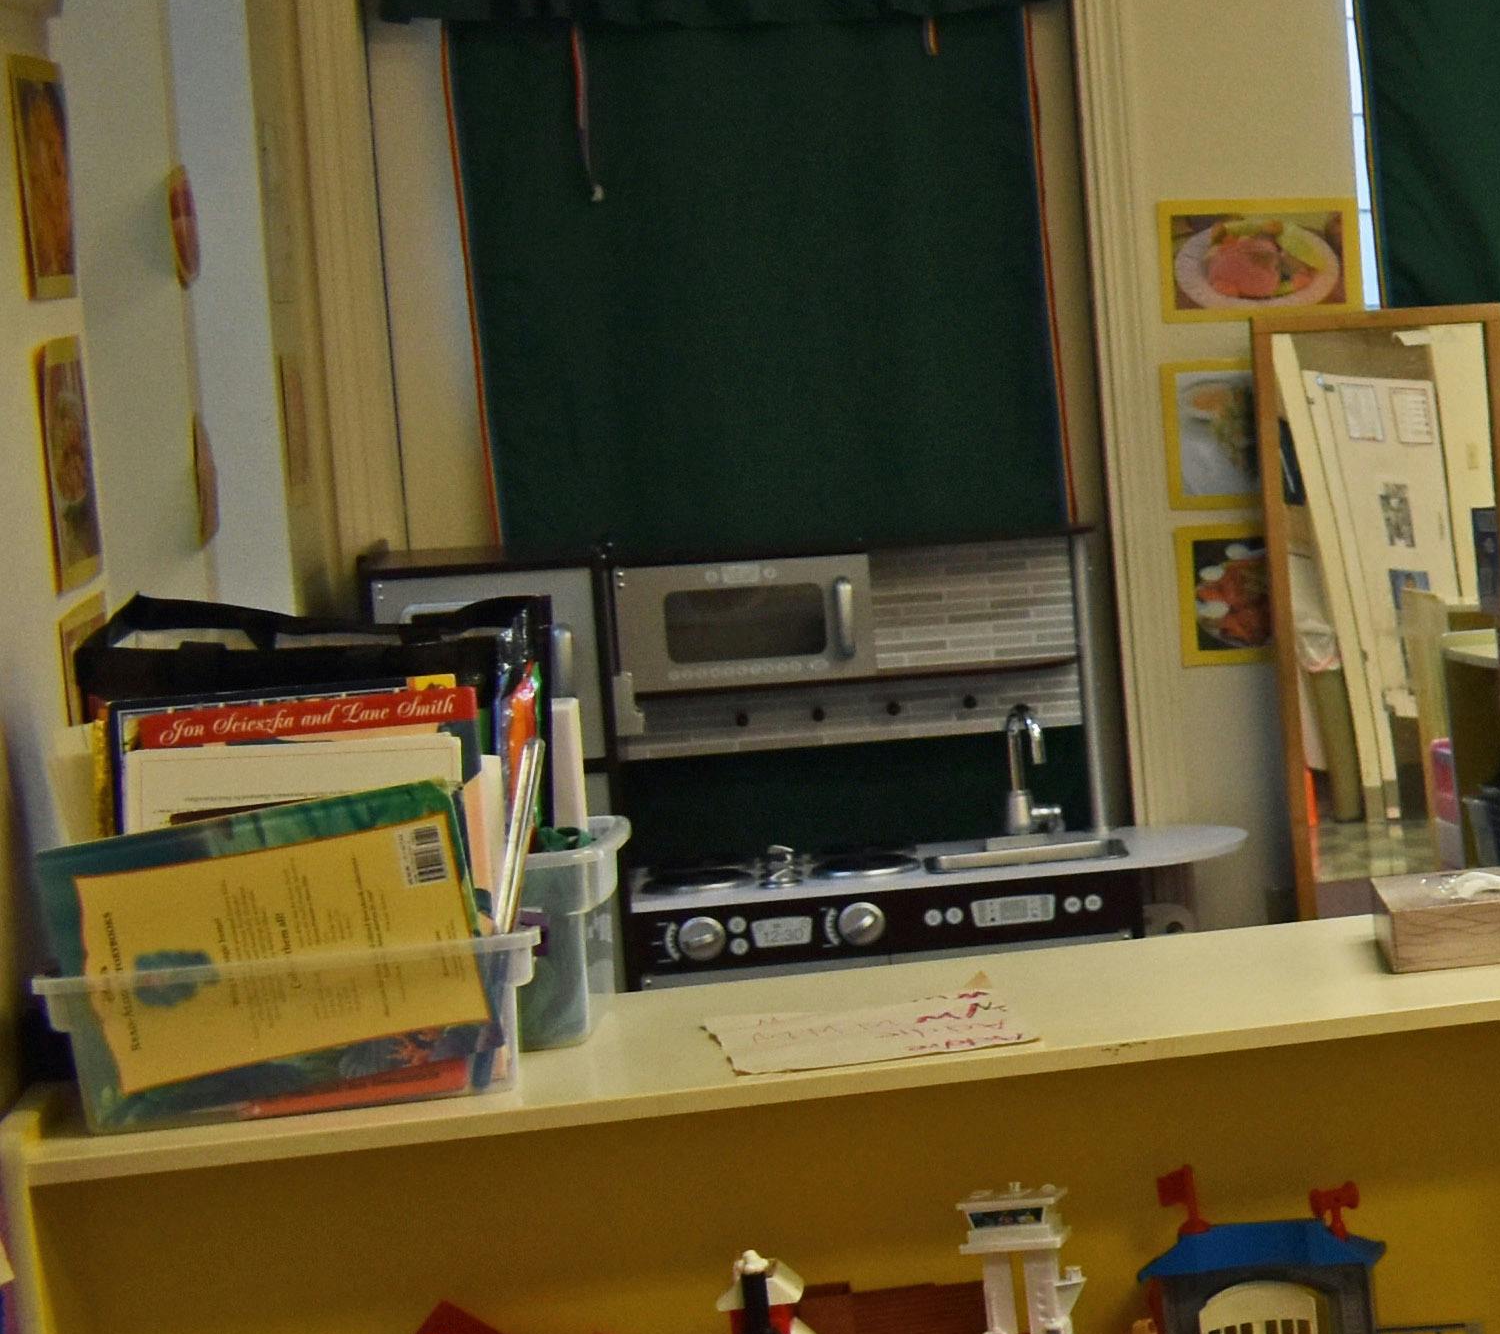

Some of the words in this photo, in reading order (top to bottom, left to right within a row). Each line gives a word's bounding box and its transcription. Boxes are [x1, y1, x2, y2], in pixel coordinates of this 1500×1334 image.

[160, 717, 205, 745] Jon
[301, 705, 336, 727] and
[397, 693, 457, 718] Smith
